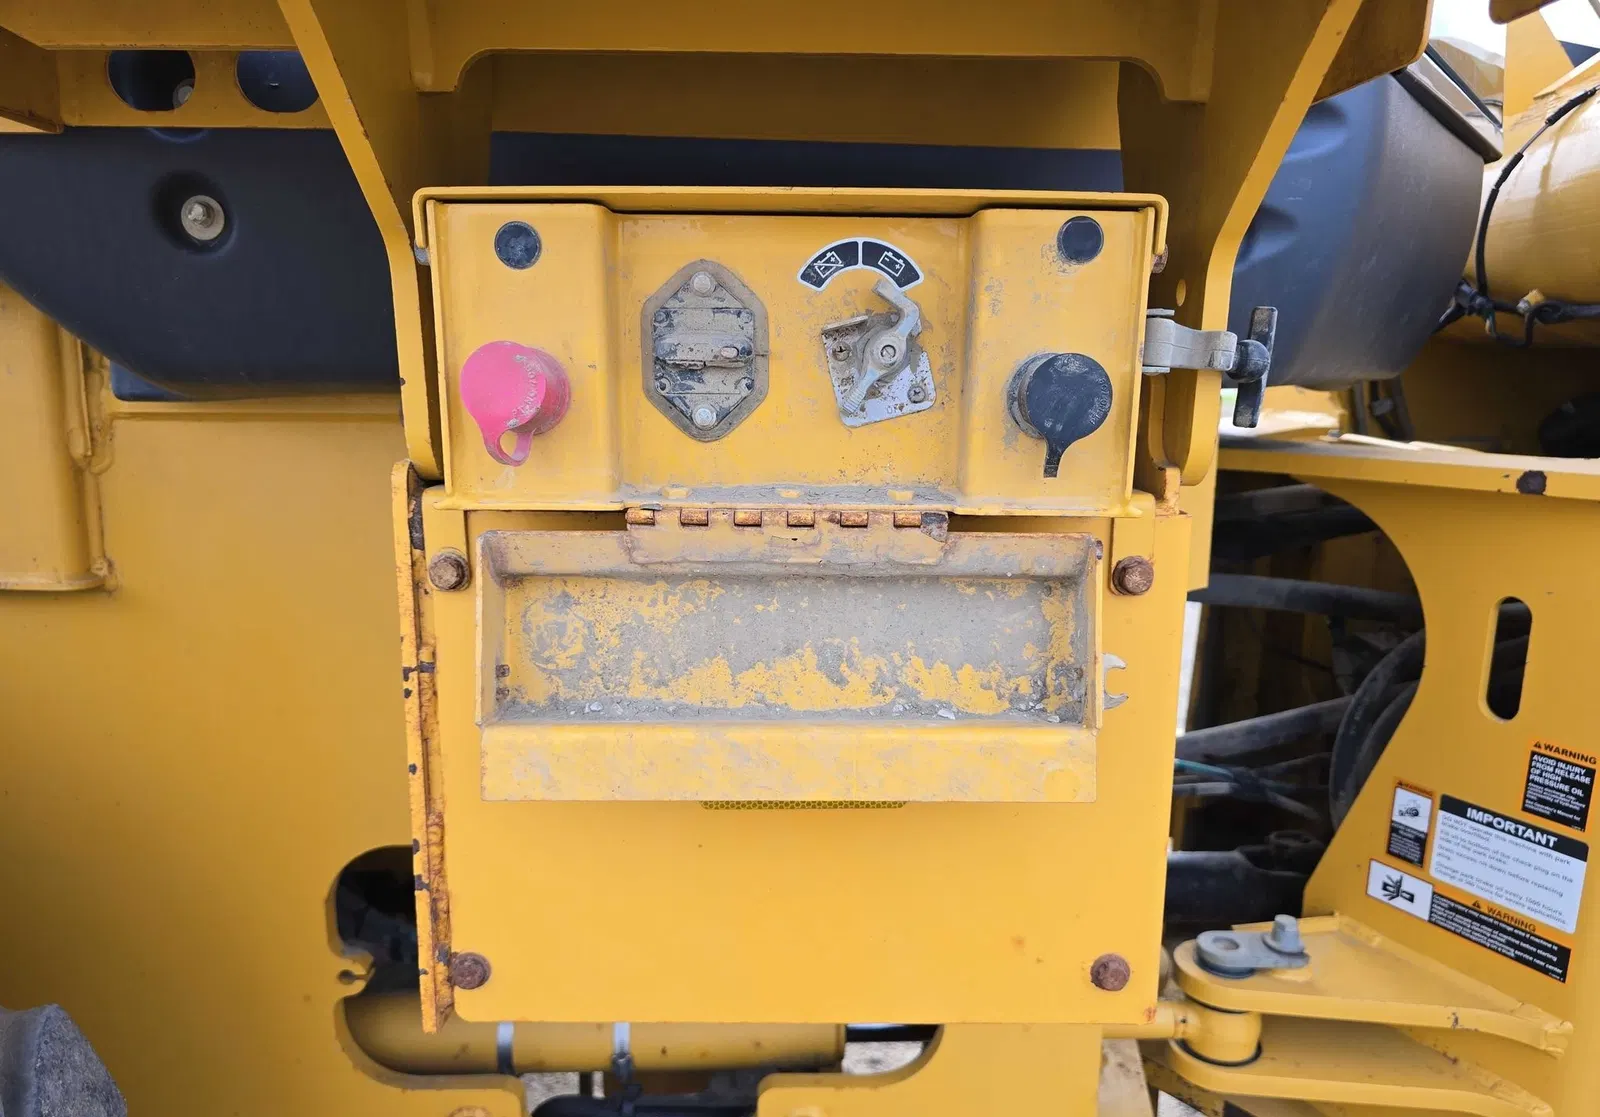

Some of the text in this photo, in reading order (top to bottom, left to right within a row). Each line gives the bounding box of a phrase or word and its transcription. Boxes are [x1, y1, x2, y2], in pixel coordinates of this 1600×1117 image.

[1533, 754, 1586, 776] AVOID INJURY
[1543, 743, 1597, 765] WARNING
[1531, 767, 1562, 782] OF HIGH
[1532, 761, 1591, 785] FROM RELEASE
[1530, 774, 1585, 797] PRESSURE OIL
[1466, 807, 1558, 849] IMPORTANT
[1486, 905, 1536, 932] WARNING
